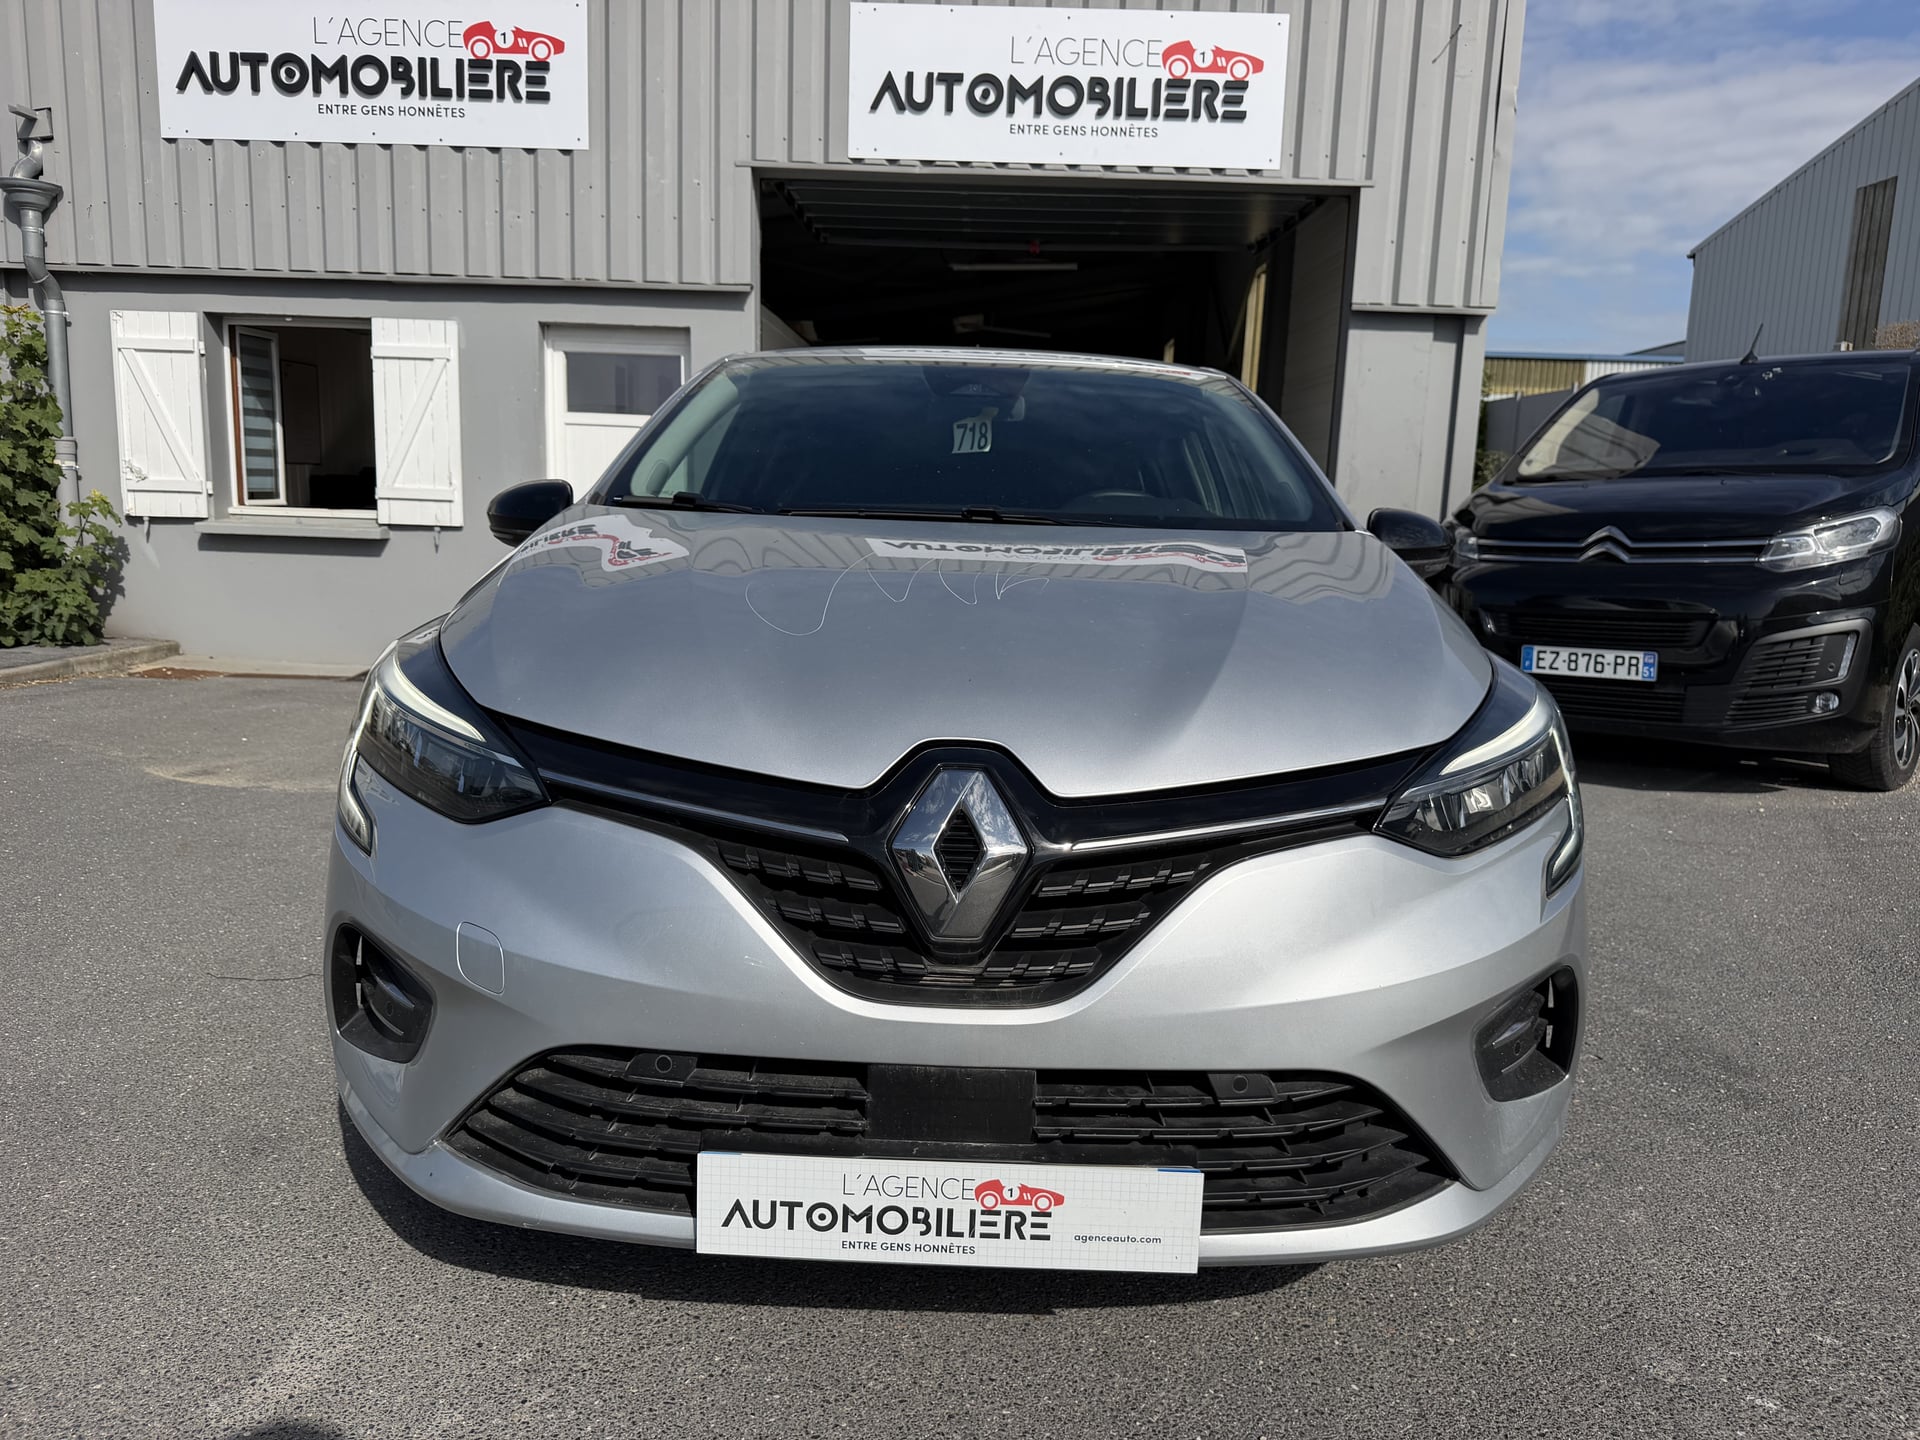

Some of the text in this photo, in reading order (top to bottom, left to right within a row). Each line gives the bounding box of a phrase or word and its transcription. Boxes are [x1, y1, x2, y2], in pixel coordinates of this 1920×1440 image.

[312, 16, 464, 49] L'AGENCE
[1010, 36, 1163, 68] L'AGENCE
[317, 103, 466, 119] ENTRE GENS HONNÊTES
[1009, 124, 1159, 138] ENTRE GENS HONNÊTES
[956, 422, 988, 451] 718
[1535, 650, 1640, 677] EZ-876-PR
[1642, 666, 1654, 678] 51
[842, 1173, 976, 1200] L'AGENCE
[841, 1240, 976, 1255] ENTRE GENS HONNÊTES
[1074, 1233, 1162, 1244] agenceauto.com
